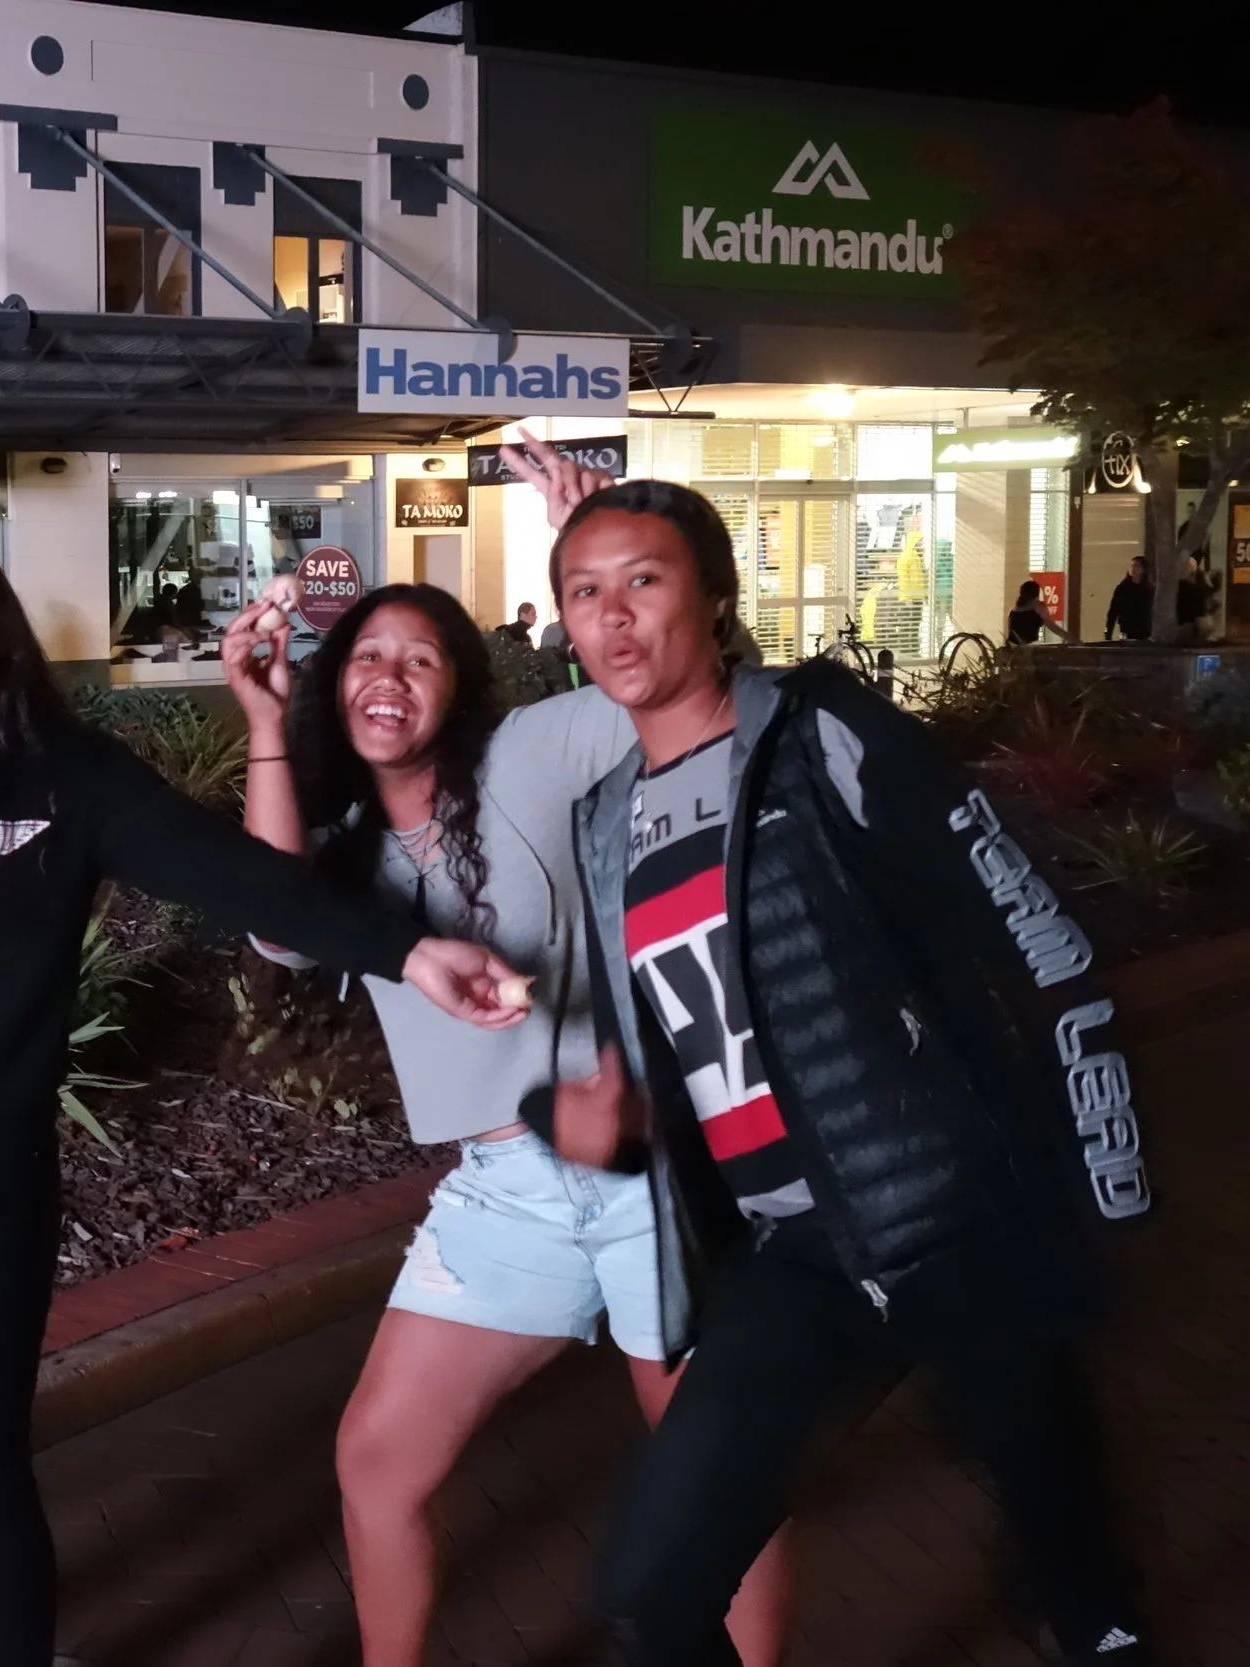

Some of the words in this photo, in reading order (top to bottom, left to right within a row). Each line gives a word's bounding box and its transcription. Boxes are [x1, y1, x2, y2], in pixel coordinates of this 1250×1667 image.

[682, 205, 943, 274] Kathmandu
[365, 346, 622, 400] Hannahs
[402, 504, 421, 518] TA
[423, 504, 463, 519] MOKO
[306, 560, 349, 577] SAVE
[948, 788, 1093, 989] TEAM
[1055, 998, 1151, 1220] LEAD
